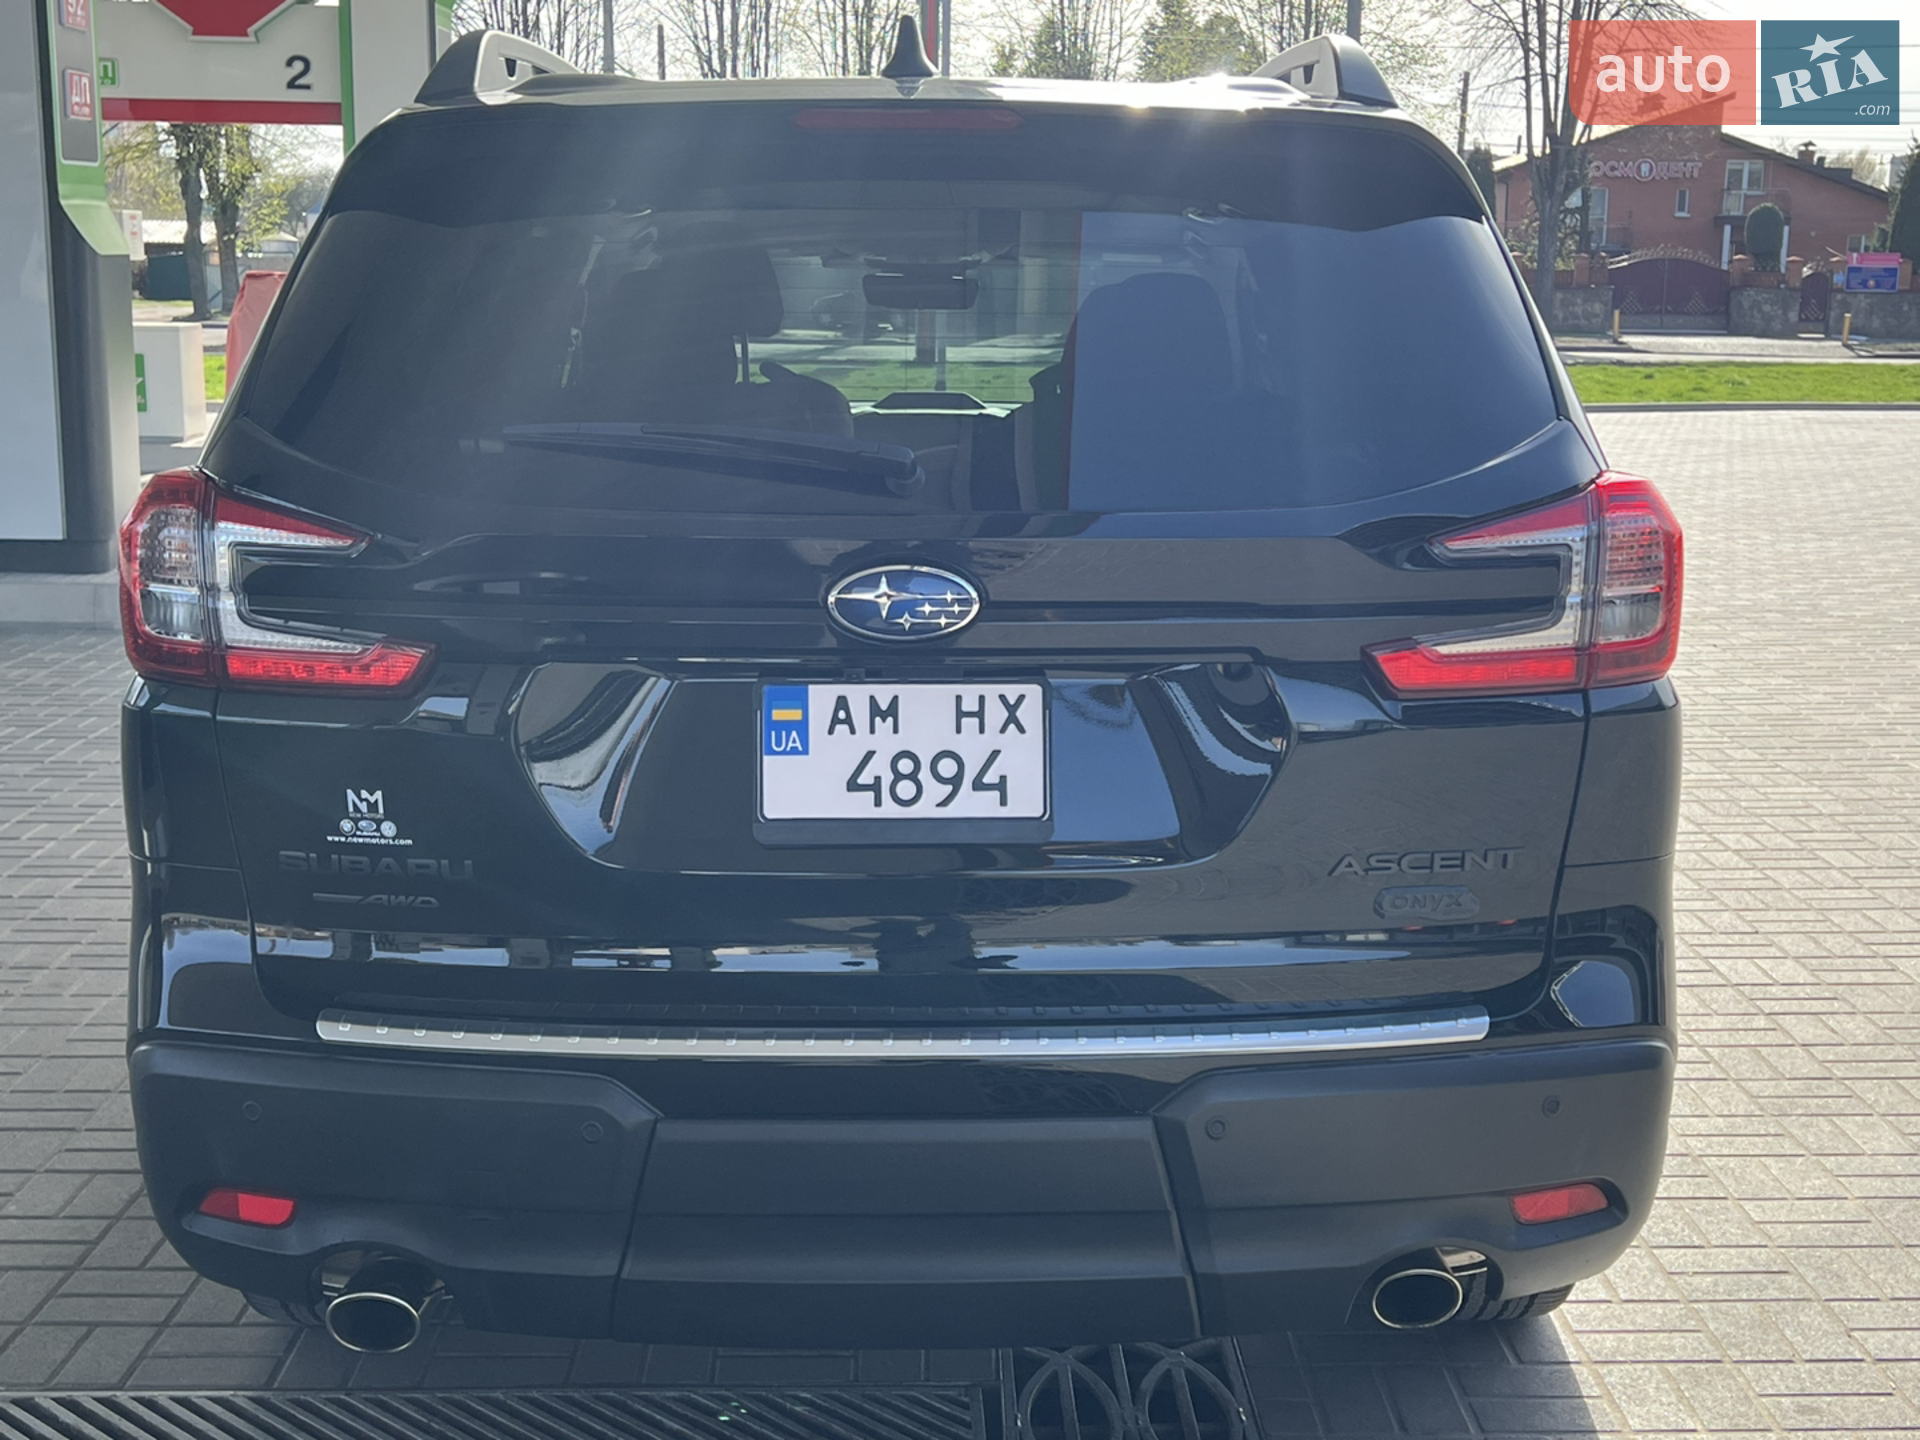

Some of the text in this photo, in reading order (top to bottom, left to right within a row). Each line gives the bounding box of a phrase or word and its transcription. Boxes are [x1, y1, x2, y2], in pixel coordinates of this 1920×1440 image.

[286, 55, 311, 90] 2
[71, 73, 91, 105] ДП
[1588, 158, 1702, 181] ОСМОДЕНТ
[827, 694, 1027, 735] AM HX
[771, 730, 803, 752] UA
[846, 749, 1008, 808] 4894
[326, 835, 413, 845] www.newmotors.com
[278, 850, 474, 881] SUBARU
[1328, 846, 1525, 876] ASCENT
[358, 893, 439, 908] AWD
[1390, 892, 1463, 912] ONYX
